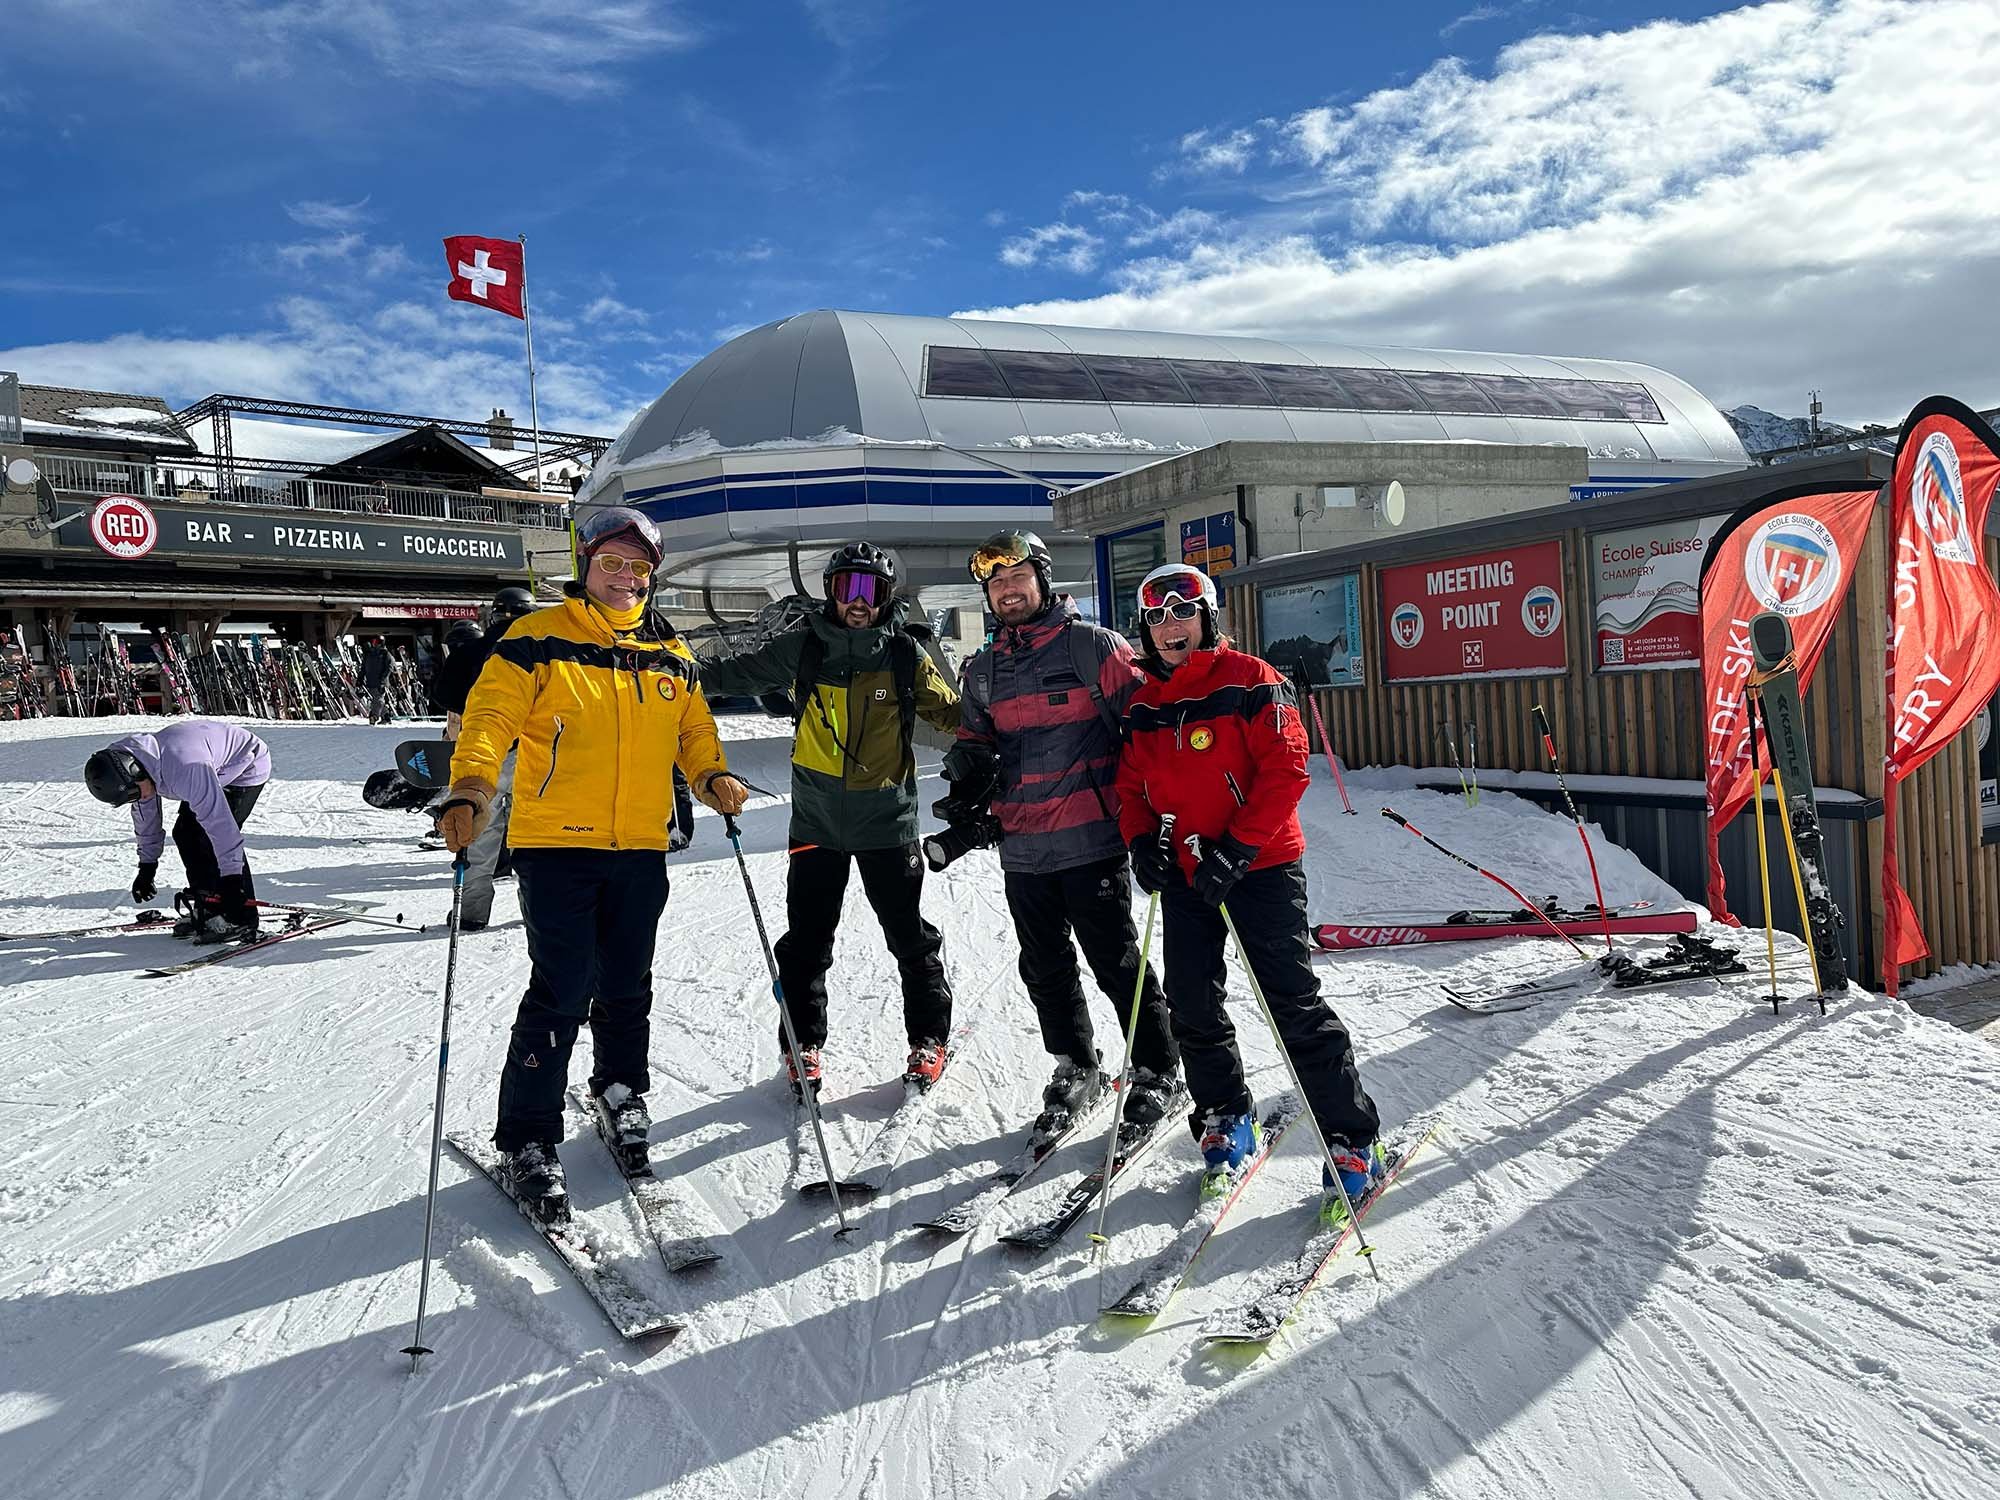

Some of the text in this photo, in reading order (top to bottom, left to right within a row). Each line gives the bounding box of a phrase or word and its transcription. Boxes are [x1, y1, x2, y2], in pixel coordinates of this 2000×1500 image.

[106, 513, 144, 538] RED
[186, 520, 232, 543] BAR
[274, 526, 365, 551] PIZZERIA
[403, 535, 507, 559] FOCACCERIA
[1767, 515, 1834, 547] ECOLE SUISSE DE SKI
[1602, 543, 1645, 564] École
[1649, 538, 1703, 557] Suisse
[1426, 560, 1514, 596] MEETING
[410, 607, 430, 616] BAR
[436, 607, 476, 617] PIZZERIA
[1442, 601, 1501, 631] POINT
[1723, 619, 1753, 679] SKI
[1711, 687, 1746, 736] DE
